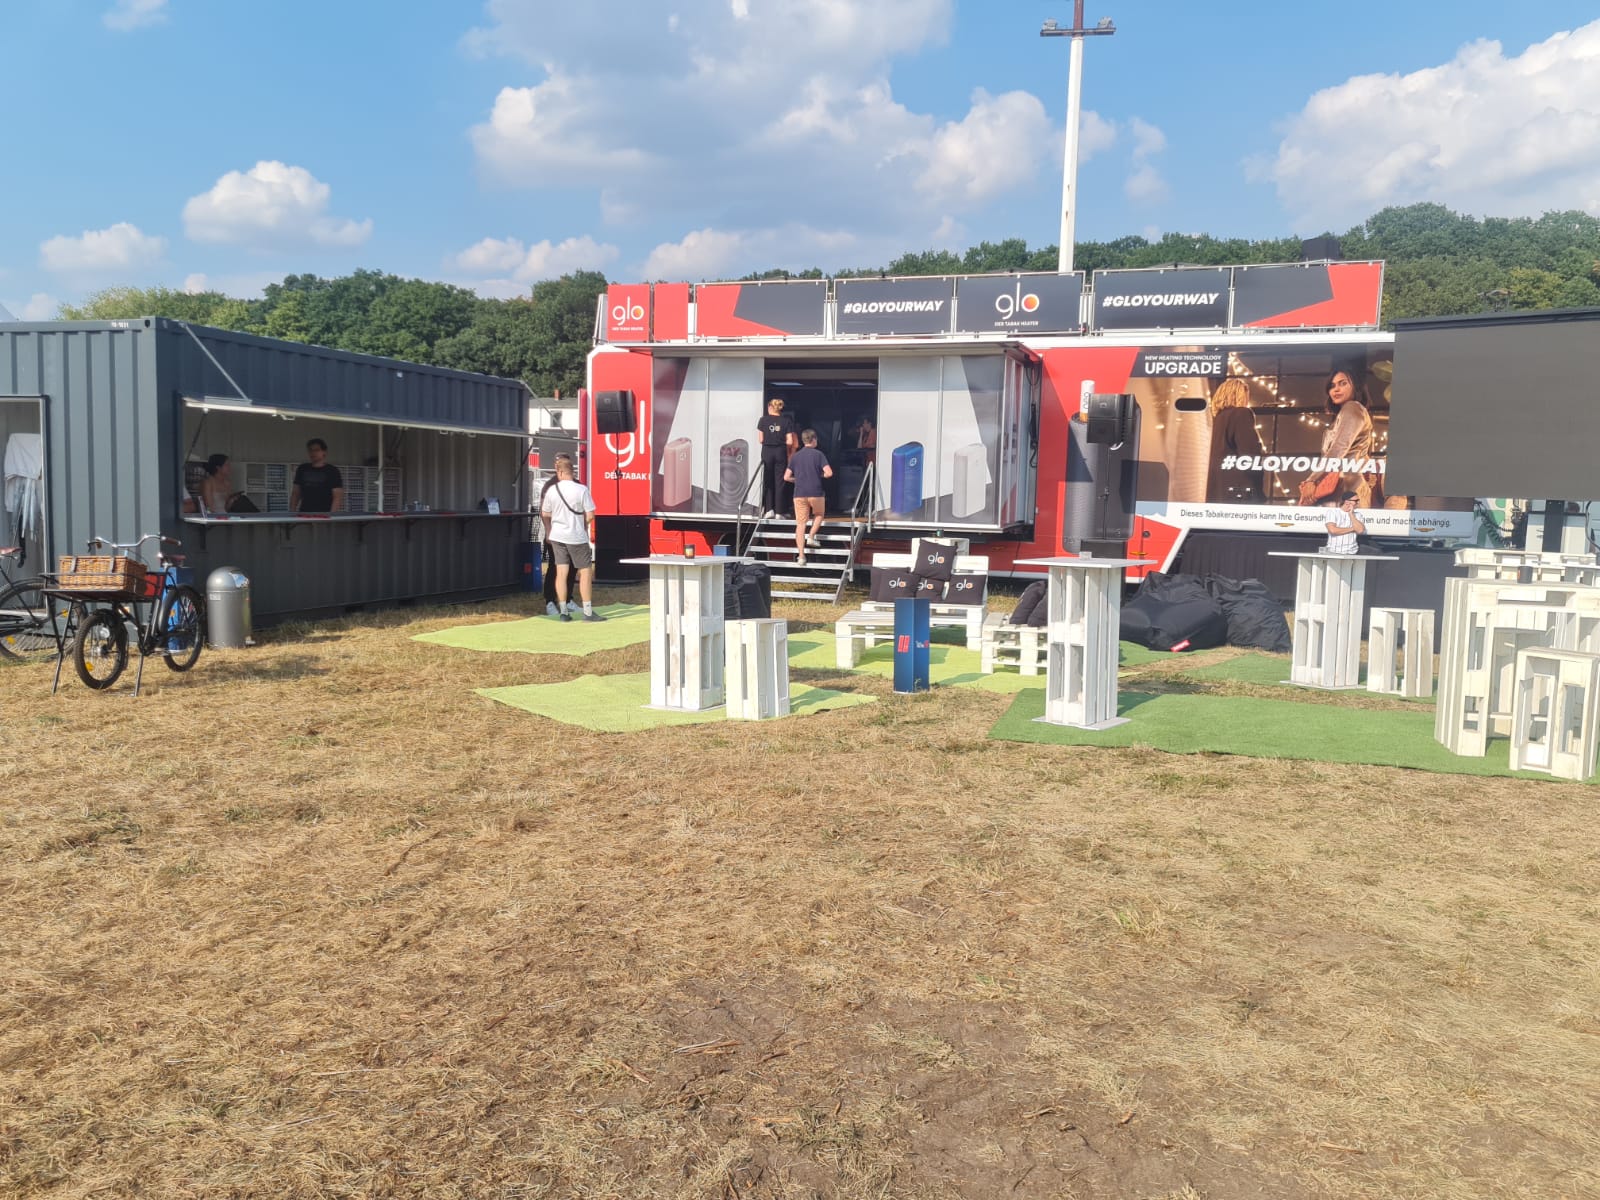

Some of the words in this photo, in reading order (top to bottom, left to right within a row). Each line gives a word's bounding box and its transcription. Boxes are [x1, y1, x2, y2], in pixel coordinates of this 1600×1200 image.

[844, 300, 944, 314] #GLOYOURWAY
[995, 282, 1040, 320] glo
[1102, 293, 1220, 307] #GLOYOURWAY
[612, 295, 645, 326] glo
[1145, 362, 1221, 374] UPGRADE
[605, 400, 652, 468] gl
[621, 472, 647, 480] TABAK
[1180, 509, 1203, 518] Dieses
[1205, 510, 1258, 521] Tabakerzeugnis
[1259, 511, 1276, 520] kann
[1278, 512, 1292, 521] Ihre
[1294, 513, 1326, 522] Gesundh
[1376, 516, 1390, 524] und
[1392, 517, 1415, 525] macht
[927, 552, 945, 564] glo
[889, 577, 906, 588] glo
[956, 578, 974, 591] glo
